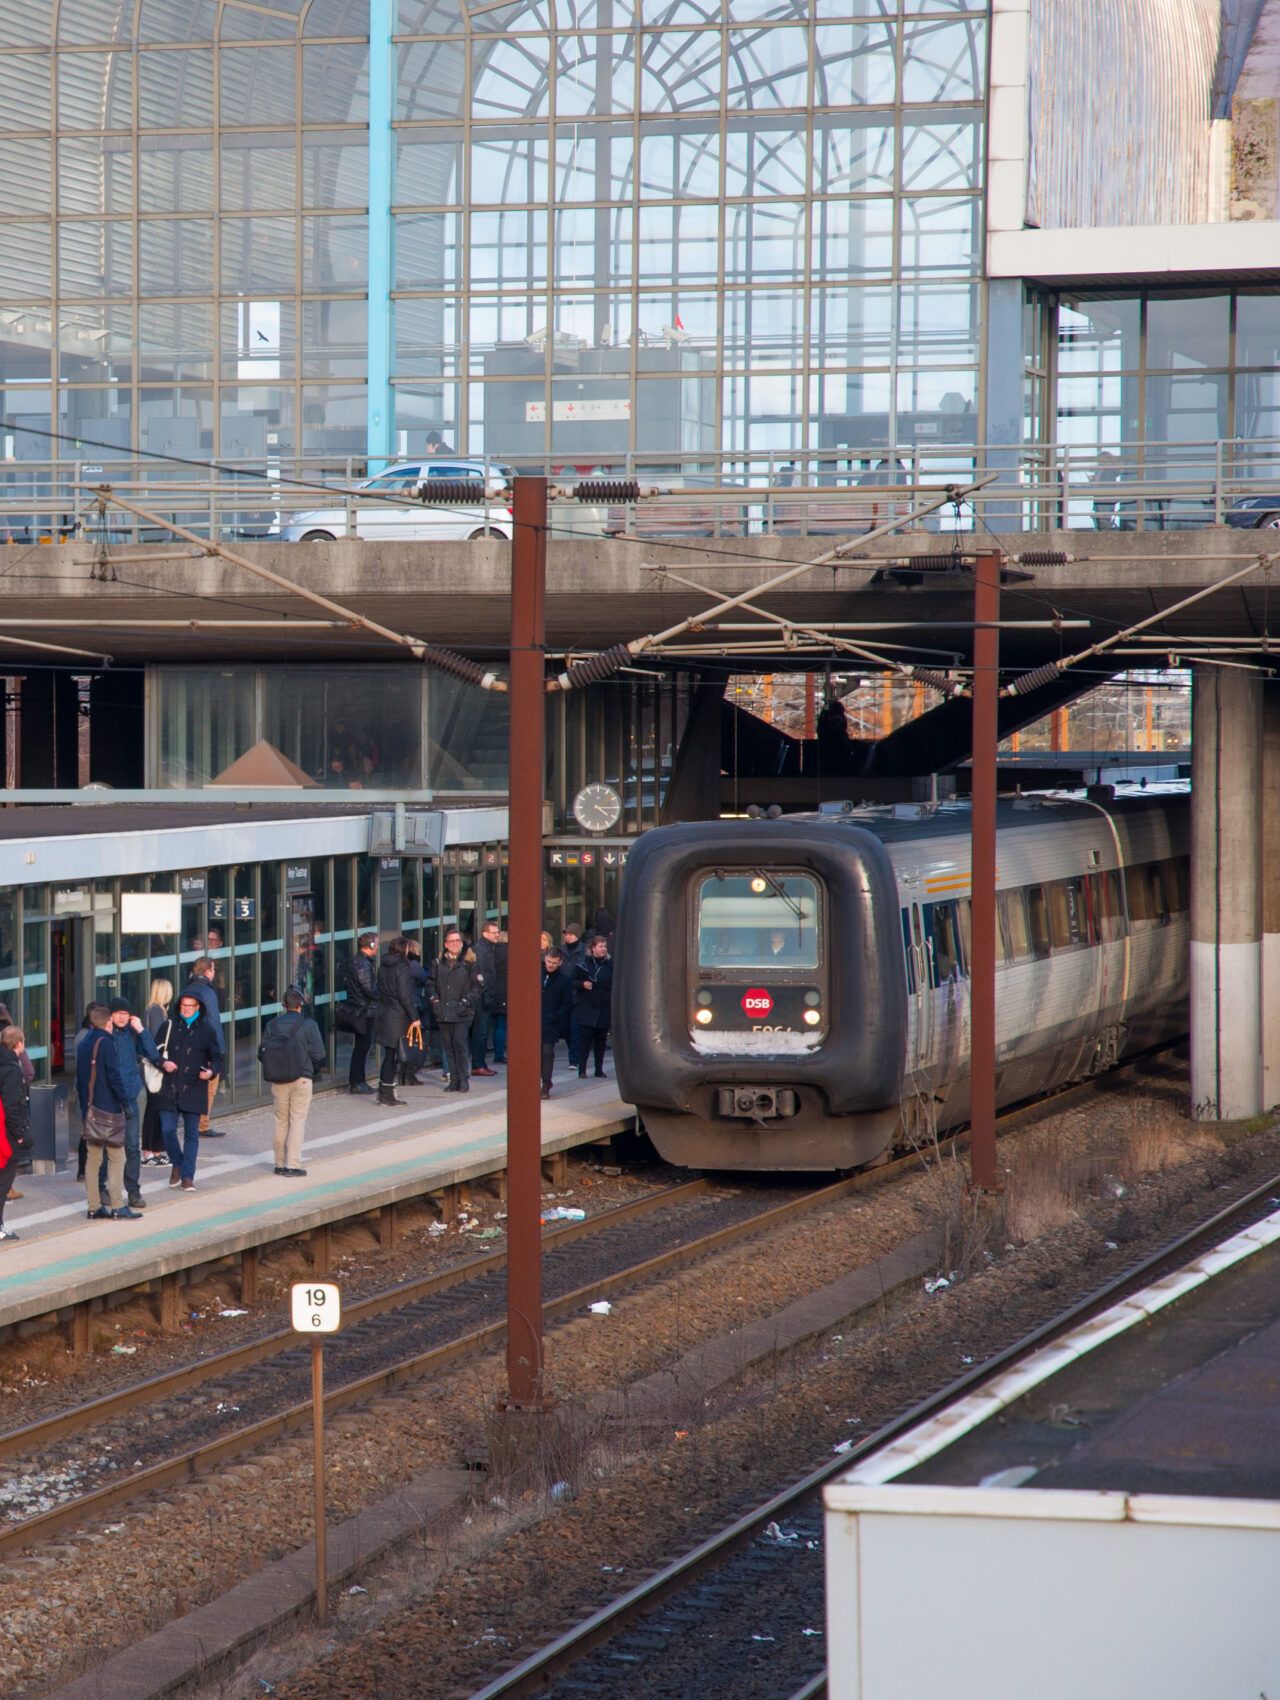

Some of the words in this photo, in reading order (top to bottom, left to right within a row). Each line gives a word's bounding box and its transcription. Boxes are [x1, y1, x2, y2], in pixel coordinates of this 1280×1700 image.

[241, 905, 250, 917] 3
[745, 998, 771, 1009] DSB
[305, 1289, 326, 1306] 19
[311, 1313, 322, 1328] 6
